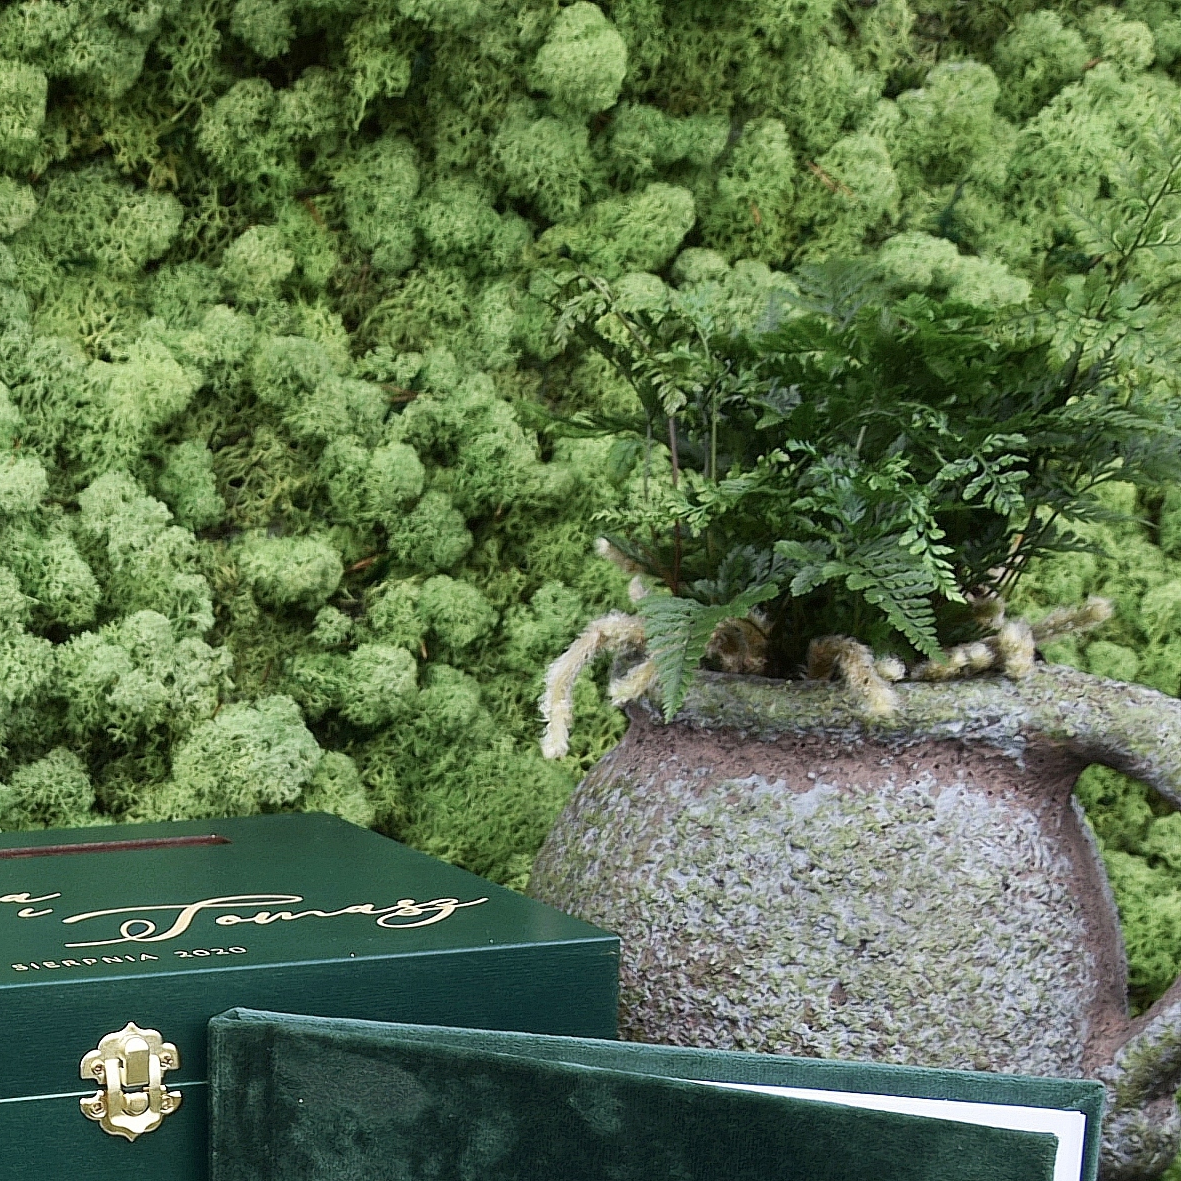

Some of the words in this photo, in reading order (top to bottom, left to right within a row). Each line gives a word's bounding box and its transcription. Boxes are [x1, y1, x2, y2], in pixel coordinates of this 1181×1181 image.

[61, 895, 489, 948] Tomasz
[11, 952, 159, 972] SIERPNIA
[174, 946, 247, 958] 2020
